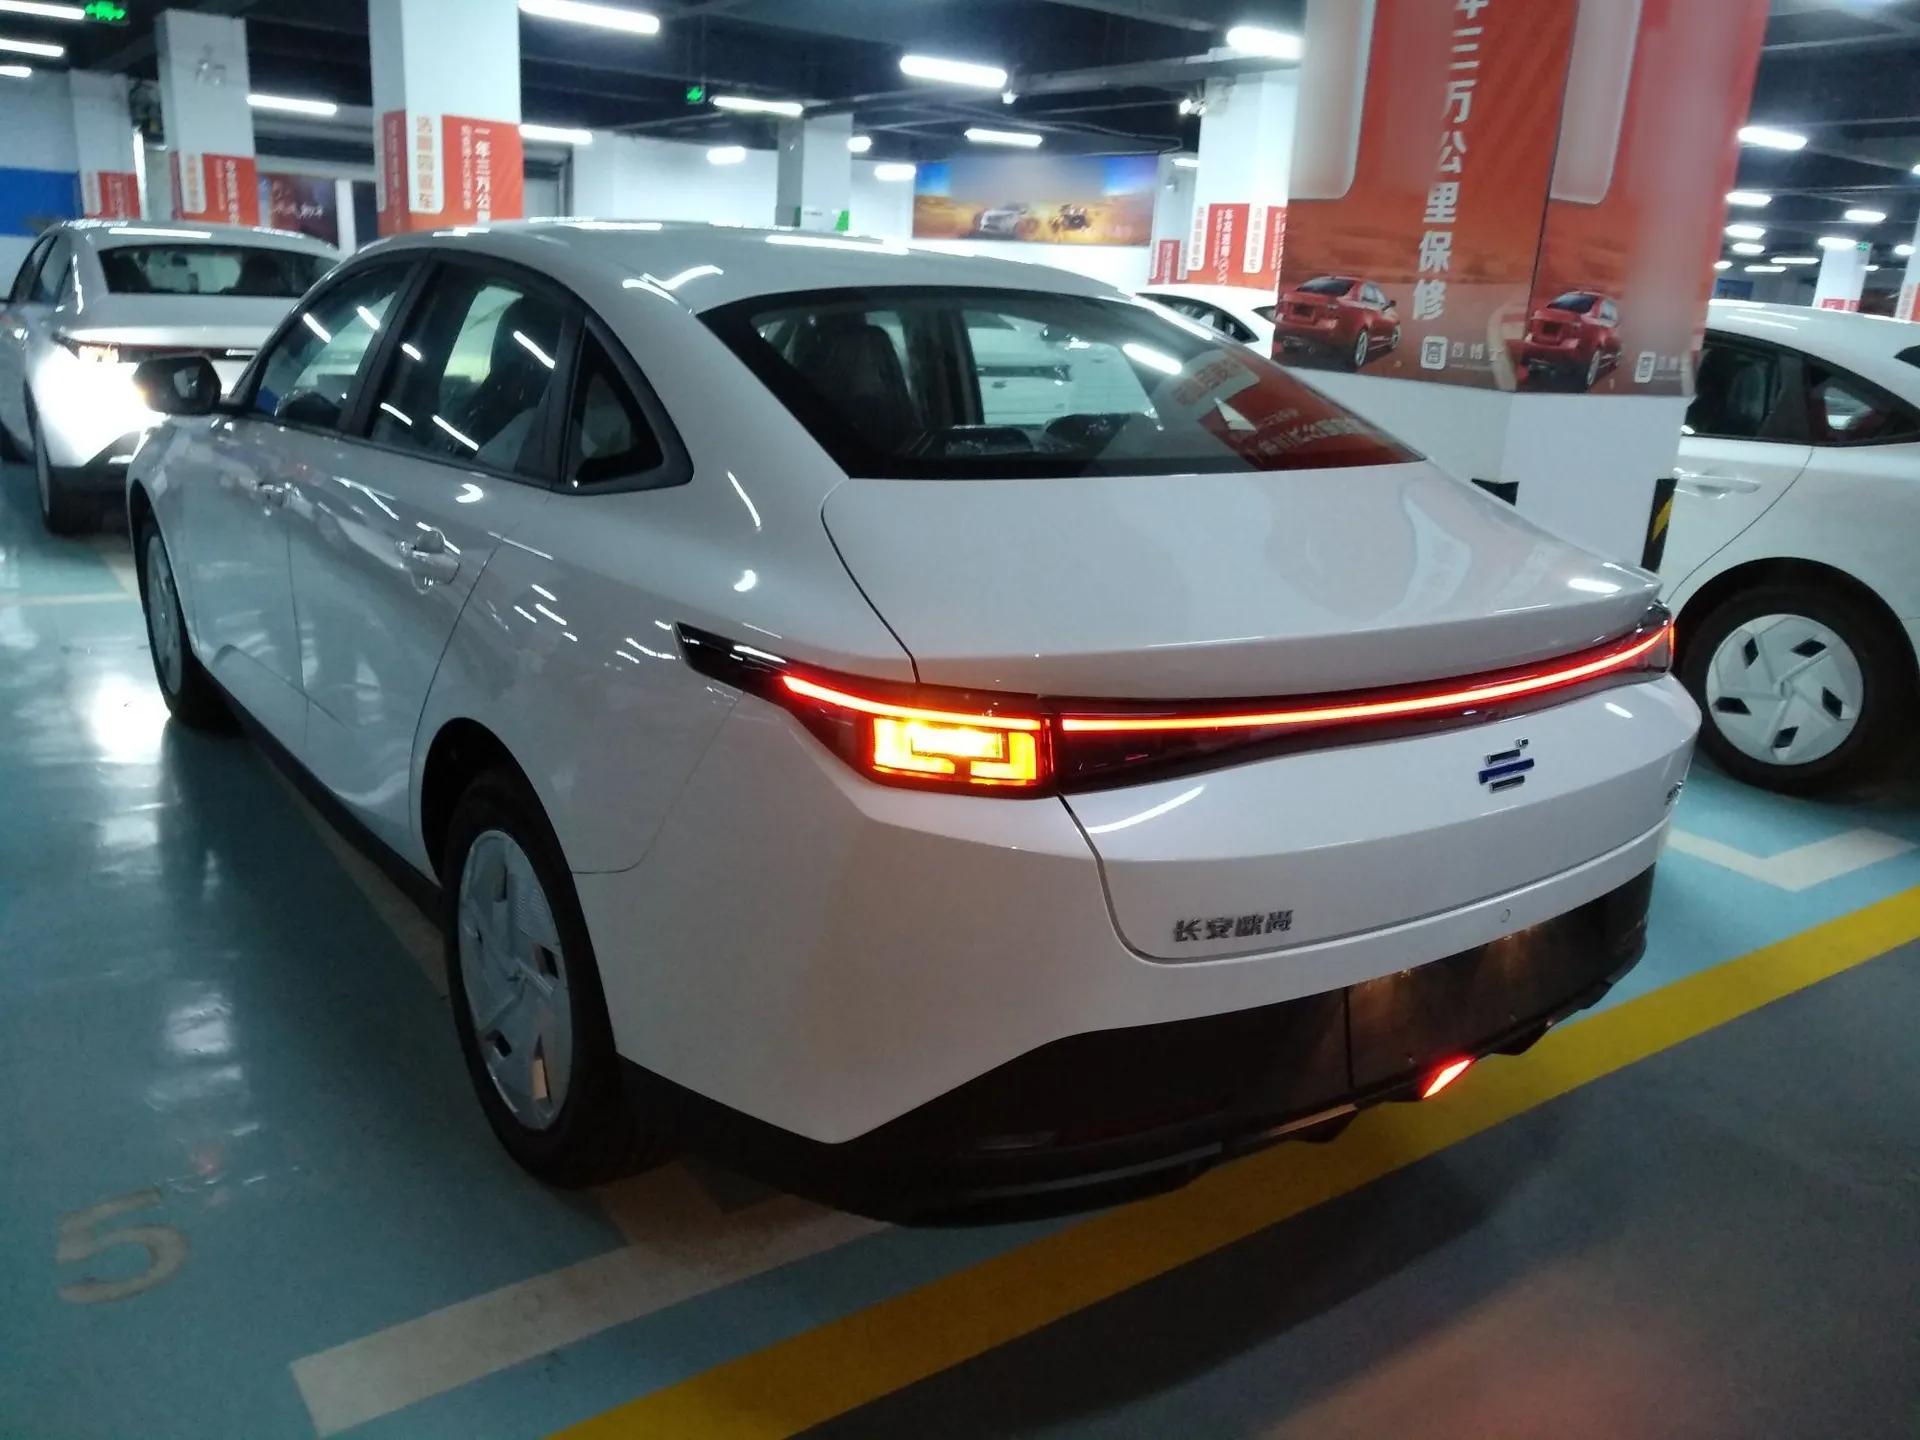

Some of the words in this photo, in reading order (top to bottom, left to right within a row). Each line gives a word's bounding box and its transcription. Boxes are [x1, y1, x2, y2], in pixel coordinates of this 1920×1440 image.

[1173, 909, 1294, 942] 长安欧尚
[57, 1188, 189, 1303] 5
